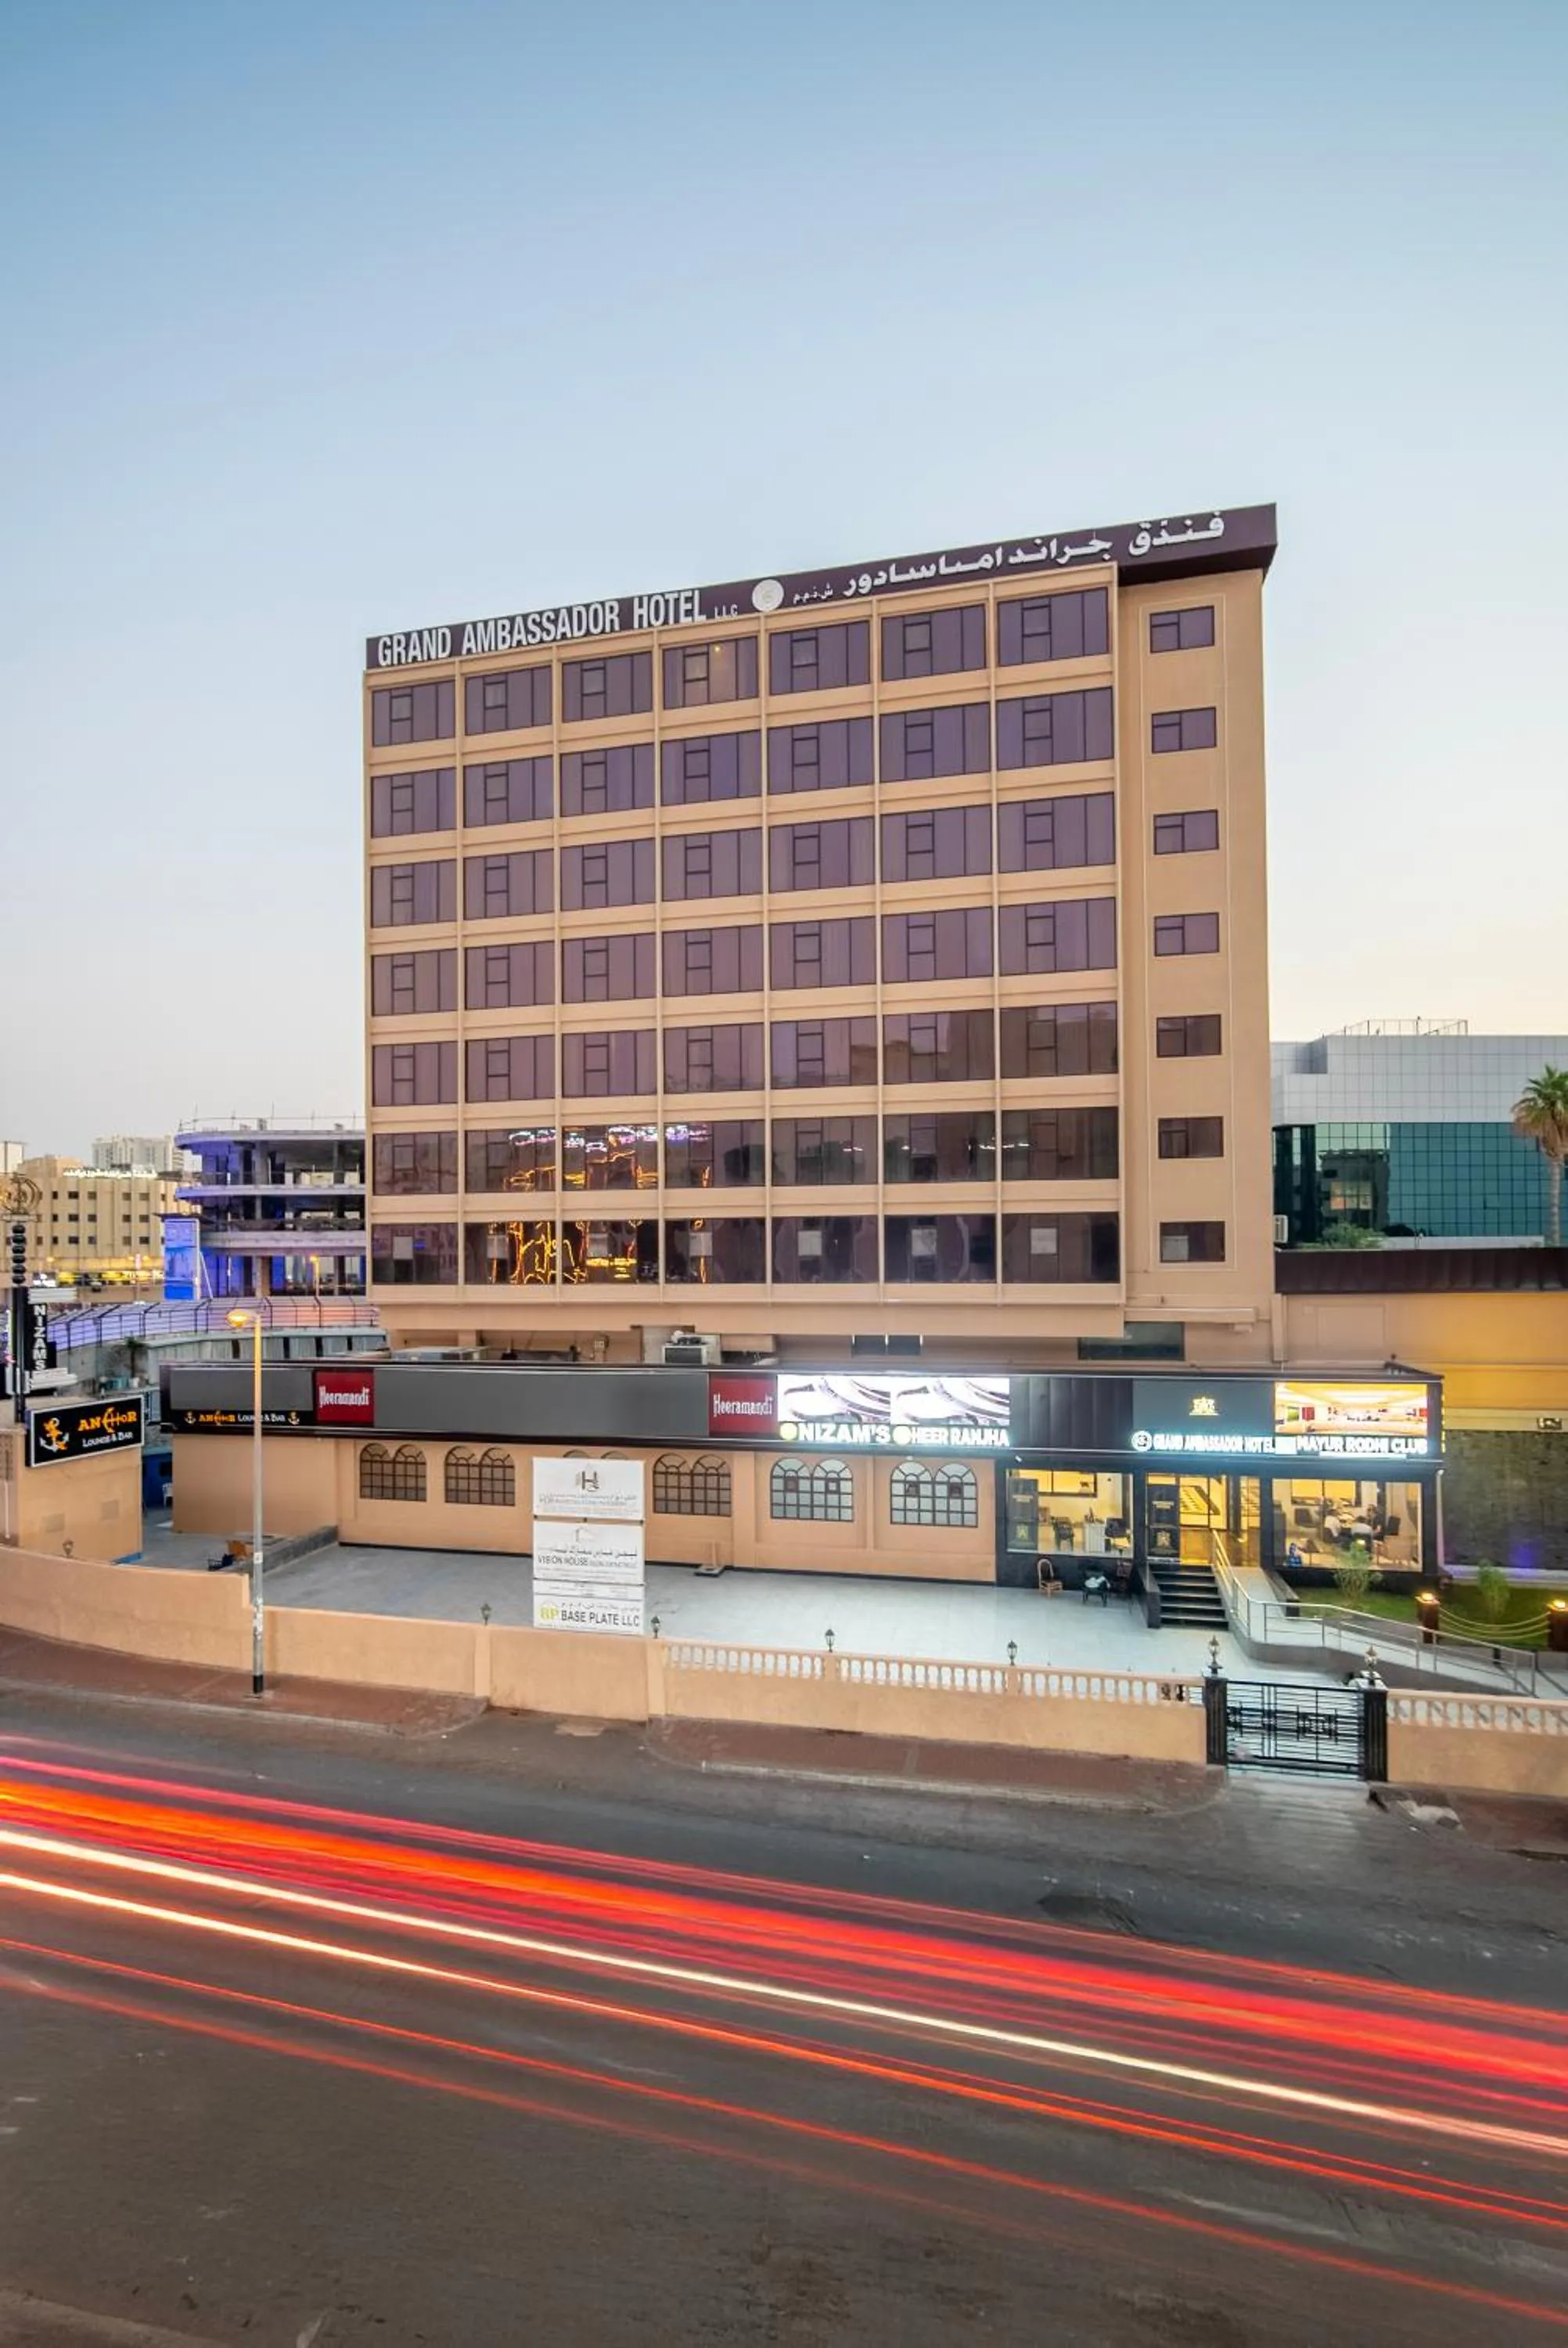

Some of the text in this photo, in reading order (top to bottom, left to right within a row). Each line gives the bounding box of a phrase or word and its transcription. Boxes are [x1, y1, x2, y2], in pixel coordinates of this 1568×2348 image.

[1129, 511, 1225, 556] فندق
[1009, 532, 1113, 564] جراند
[377, 589, 738, 668] GRAND AMBASSADOR HOTEL LLC
[33, 1305, 47, 1370] NIZAMS
[319, 1385, 370, 1408] Heeramandi
[713, 1392, 773, 1417] Heeramandi
[798, 1423, 890, 1443] NIZAM'S
[912, 1427, 949, 1445] HEER
[1244, 1436, 1275, 1453] HOTEL
[1391, 1438, 1428, 1454] CLUB
[561, 1610, 586, 1622] BASE
[588, 1612, 619, 1626] PLATE
[622, 1615, 639, 1627] LLC
